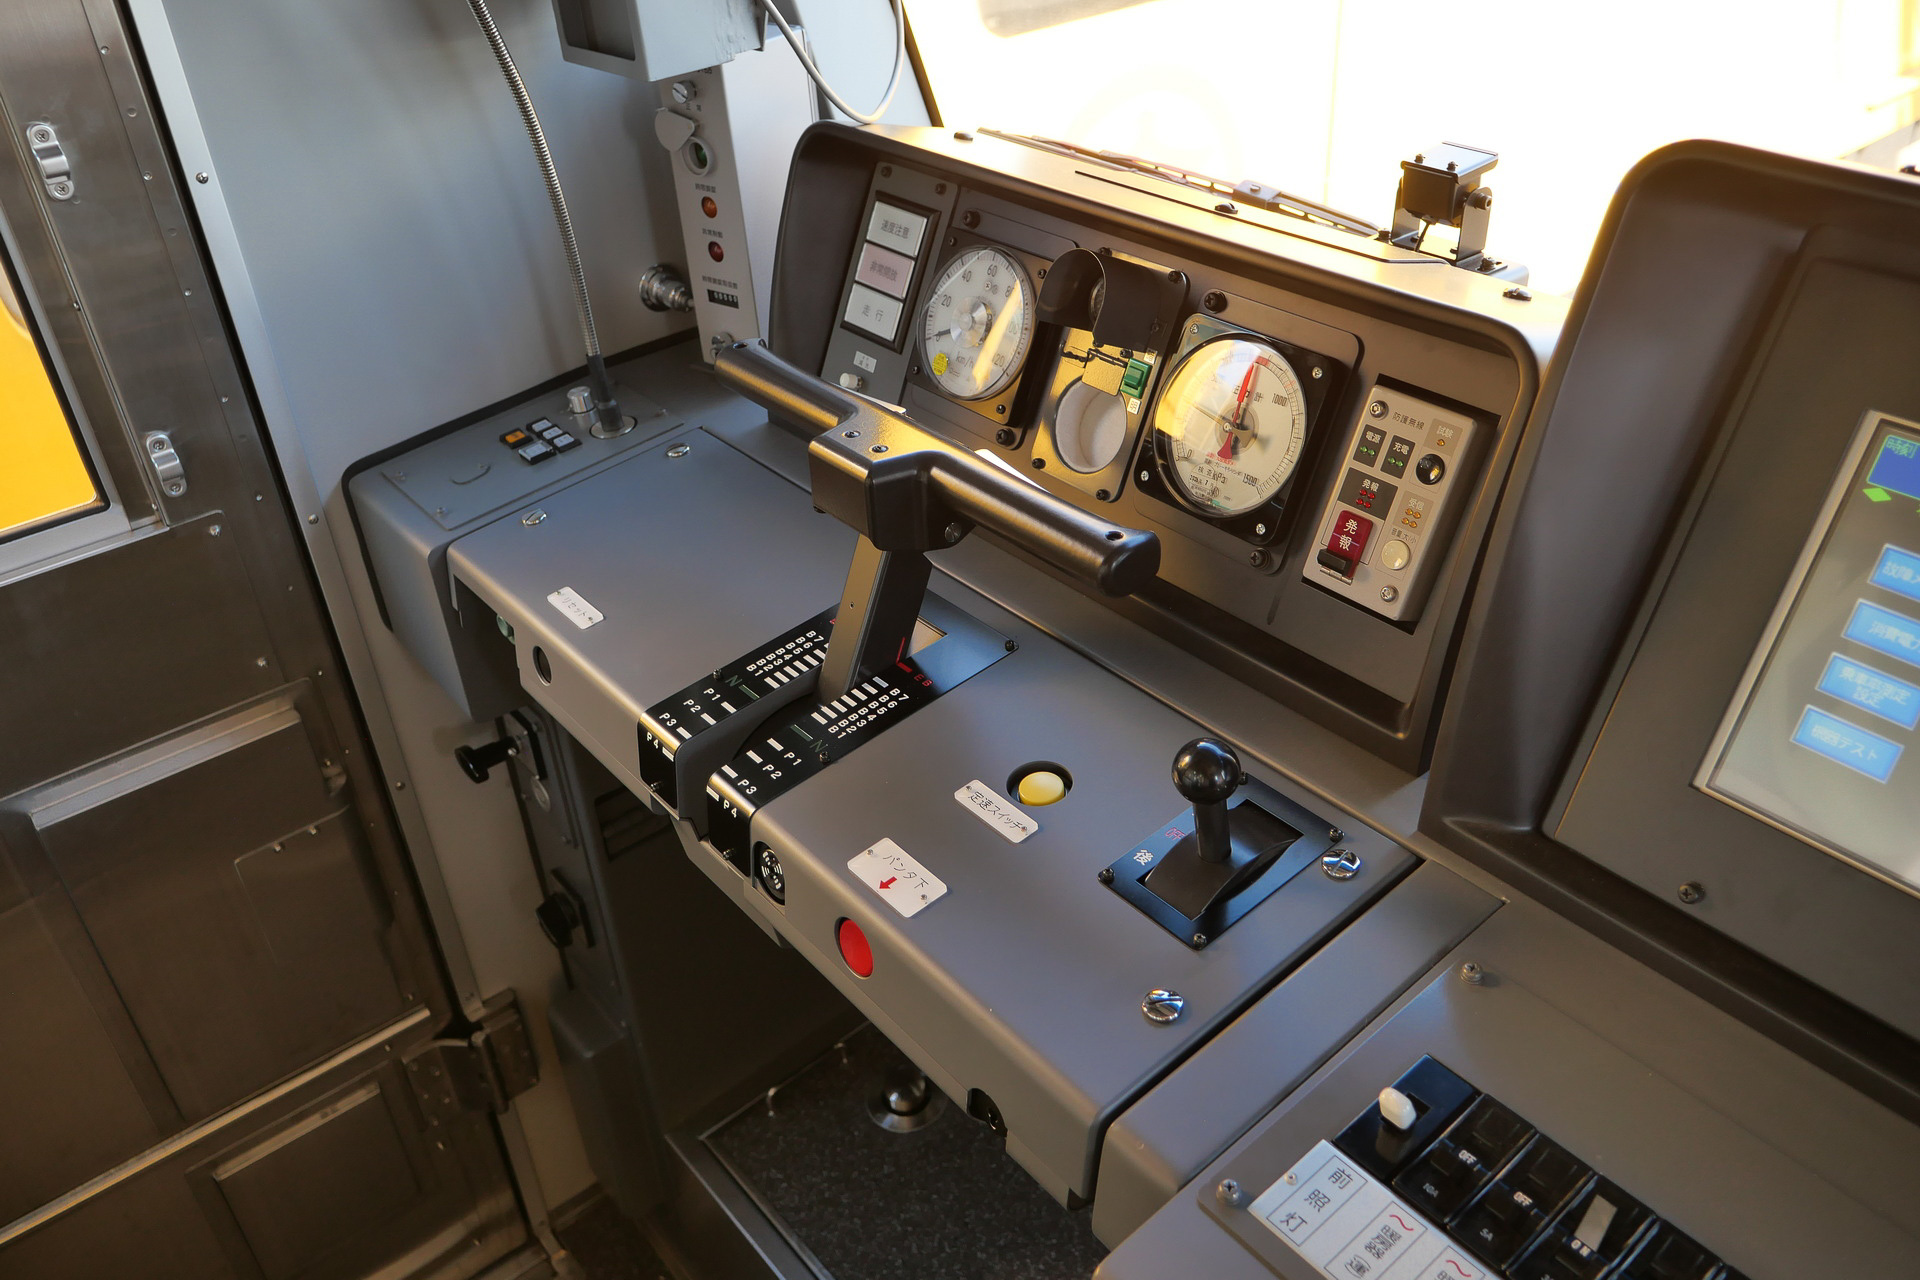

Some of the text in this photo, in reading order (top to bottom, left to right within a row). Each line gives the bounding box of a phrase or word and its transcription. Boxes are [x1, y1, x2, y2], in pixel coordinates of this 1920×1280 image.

[881, 219, 910, 239] 速度注意
[962, 270, 972, 283] 40
[987, 264, 998, 278] 60
[941, 294, 952, 308] 20
[1272, 392, 1287, 407] 1000
[1392, 411, 1425, 431] 防護無線
[1366, 430, 1382, 444] 電源
[1436, 425, 1454, 439] 試験
[1186, 448, 1193, 459] 0
[1393, 441, 1410, 455] 充電
[1887, 438, 1919, 459] 時刻
[1242, 472, 1259, 488] 1500
[1361, 478, 1380, 493] 発報
[1408, 498, 1425, 511] 受信
[1339, 518, 1359, 552] 発報
[795, 636, 813, 649] B6
[805, 630, 824, 642] B7
[775, 647, 793, 661] B4
[785, 641, 803, 655] B5
[756, 658, 774, 672] B2
[765, 653, 783, 666] B3
[746, 663, 764, 677] B1
[725, 675, 743, 687] N
[914, 673, 934, 687] EB
[703, 687, 721, 701] P1
[889, 688, 910, 701] B7
[683, 699, 701, 713] P2
[868, 701, 888, 715] B5
[878, 694, 898, 709] B6
[659, 712, 677, 727] P3
[848, 713, 867, 727] B3
[858, 707, 877, 721] B4
[828, 725, 847, 739] B1
[838, 719, 857, 734] B2
[646, 731, 659, 749] P4
[809, 739, 829, 752] N
[783, 751, 802, 766] P1
[762, 764, 782, 780] P2
[737, 779, 757, 795] P3
[723, 799, 738, 818] P4
[968, 791, 1023, 829] 定速スイッチ
[1165, 827, 1187, 841] OFF
[1133, 849, 1155, 866] 後
[882, 854, 930, 890] パンタ下
[1458, 1149, 1478, 1165] OFF
[1280, 1167, 1354, 1233] 前照灯
[1513, 1191, 1534, 1208] OFF
[1570, 1239, 1592, 1257] ON
